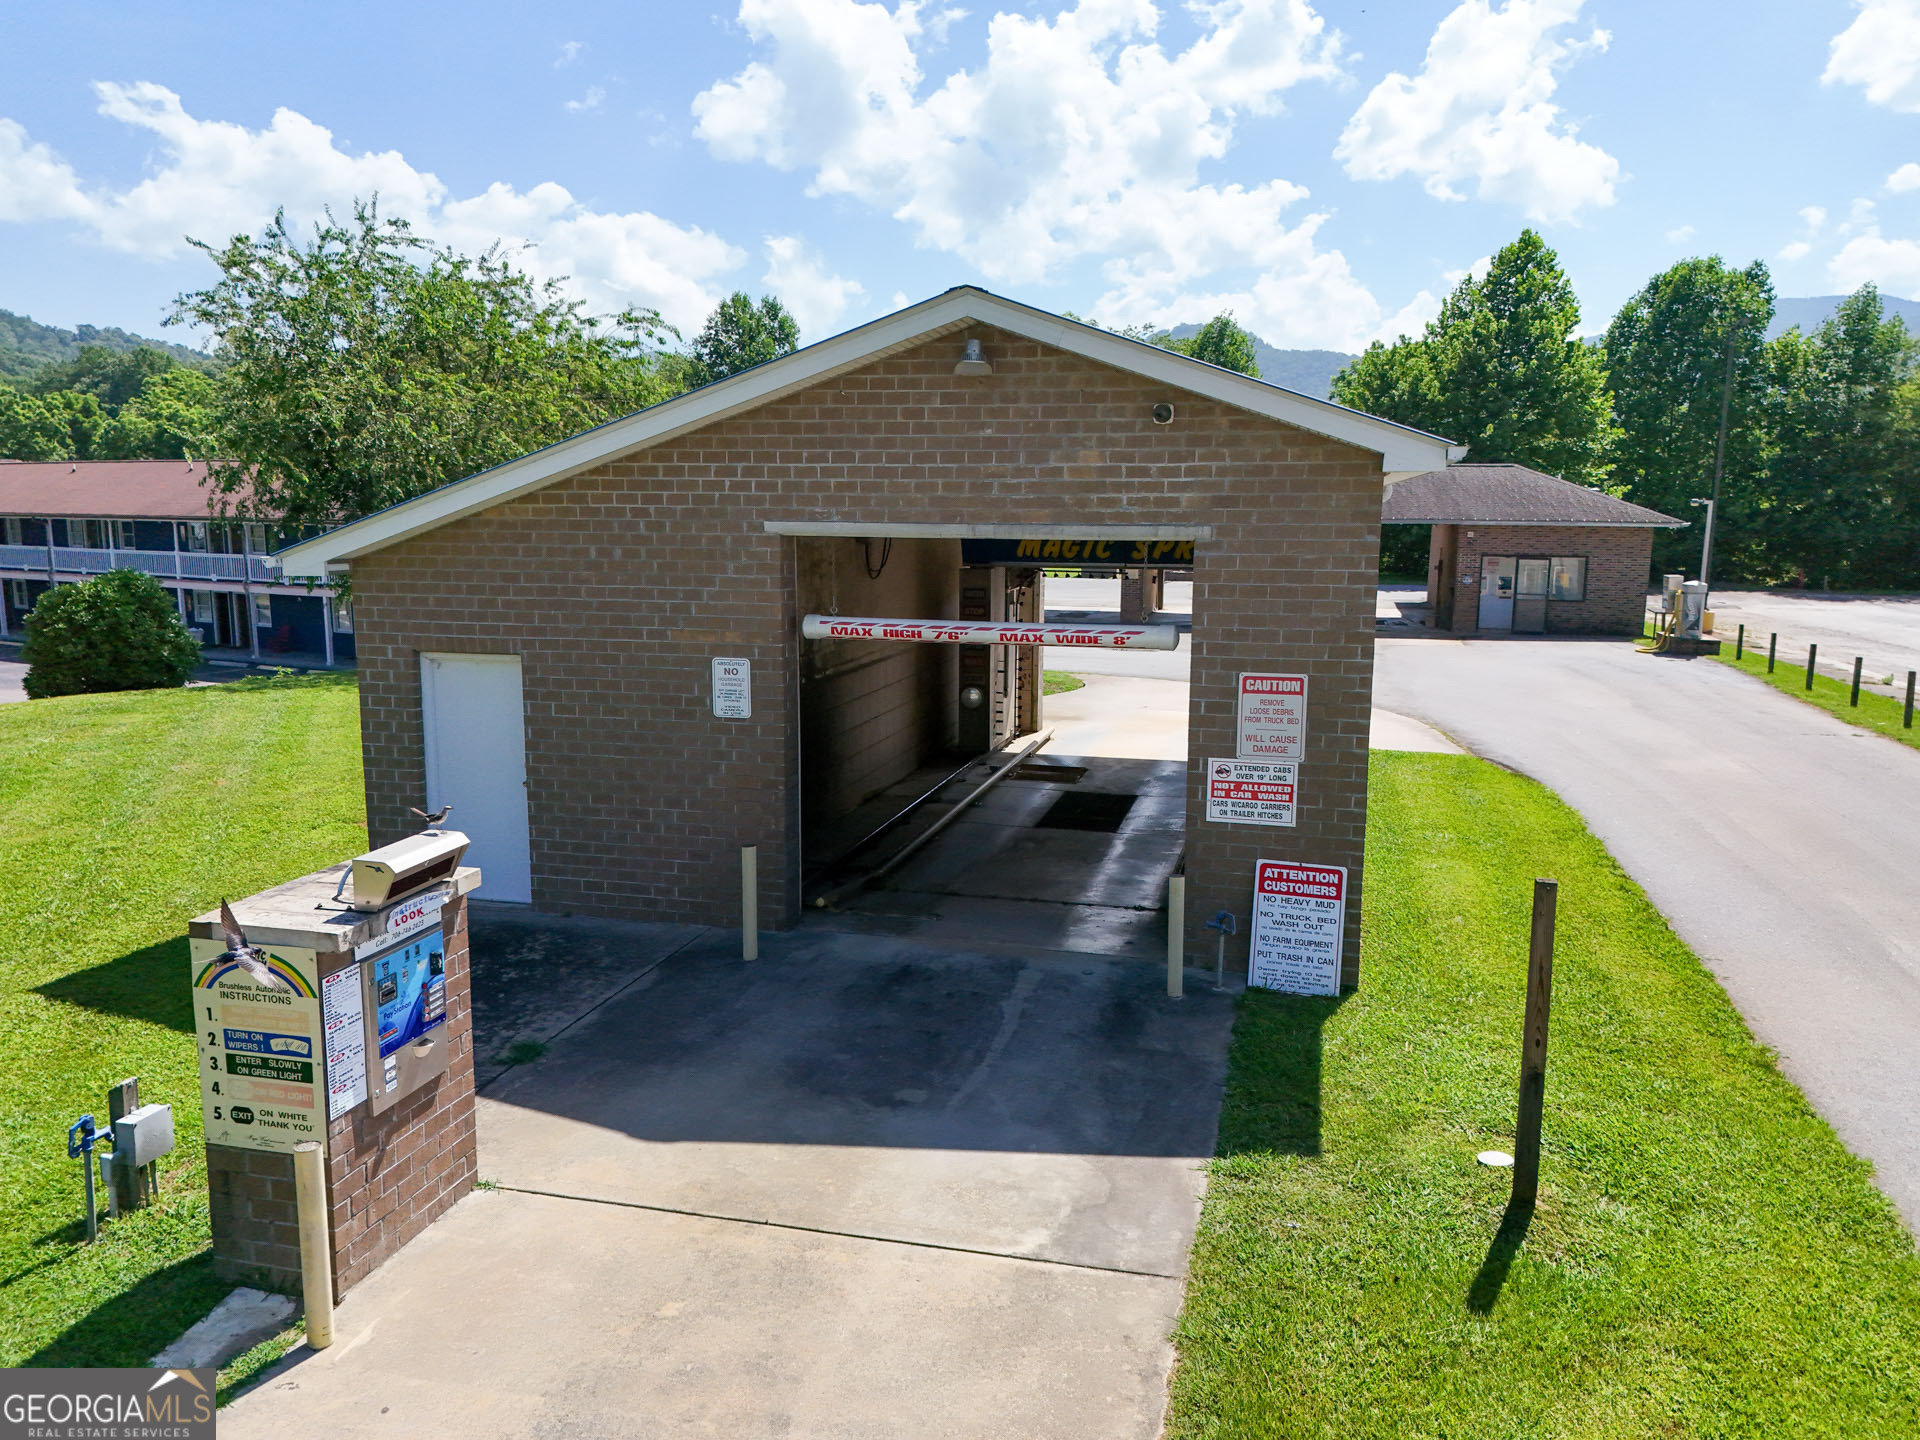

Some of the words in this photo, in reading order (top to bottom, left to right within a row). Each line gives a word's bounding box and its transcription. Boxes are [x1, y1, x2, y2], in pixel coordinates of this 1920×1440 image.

[831, 627, 873, 637] MAX
[883, 628, 922, 639] HIGH
[1000, 633, 1044, 642] MAX
[1055, 635, 1102, 644] WIDE
[1114, 637, 1131, 645] 8'
[1246, 679, 1300, 692] CAUTION
[1253, 745, 1288, 753] DAMAGE
[1241, 784, 1291, 792] ALLOWED
[1258, 793, 1289, 801] WASH
[1261, 803, 1290, 811] CARRIERS
[1231, 810, 1255, 818] TRAILER
[1264, 868, 1338, 884] ATTENTION
[1264, 881, 1336, 896] CUSTOMERS
[1281, 897, 1310, 906] HEAVY
[1315, 900, 1335, 909] MUD
[395, 907, 423, 927] LOOK
[1280, 913, 1312, 922] TRUCK
[1273, 936, 1291, 944] FARM
[1295, 939, 1333, 949] EQUIPMENT
[1257, 950, 1272, 958] PUT
[1277, 952, 1302, 962] TRASH
[1318, 958, 1334, 966] CAN
[219, 981, 251, 991] Brushless
[220, 991, 291, 1005] INSTRUCTIONS
[206, 1007, 218, 1021] 1.
[384, 1012, 393, 1020] Pay
[394, 1002, 411, 1015] Station
[208, 1032, 220, 1046] 2.
[227, 1031, 249, 1039] TURN
[251, 1033, 263, 1041] ON
[228, 1041, 258, 1050] WIPERS
[210, 1057, 222, 1071] 3.
[235, 1056, 261, 1065] ENTER
[269, 1060, 302, 1069] SLOWLY
[237, 1066, 249, 1074] ON
[251, 1069, 277, 1078] GREEN
[280, 1072, 302, 1081] LIGHT
[212, 1082, 224, 1096] 4.
[214, 1106, 226, 1120] 5.
[232, 1111, 252, 1120] EXIT
[278, 1111, 307, 1121] WHITE
[258, 1119, 289, 1129] THANK
[293, 1123, 312, 1132] YOU
